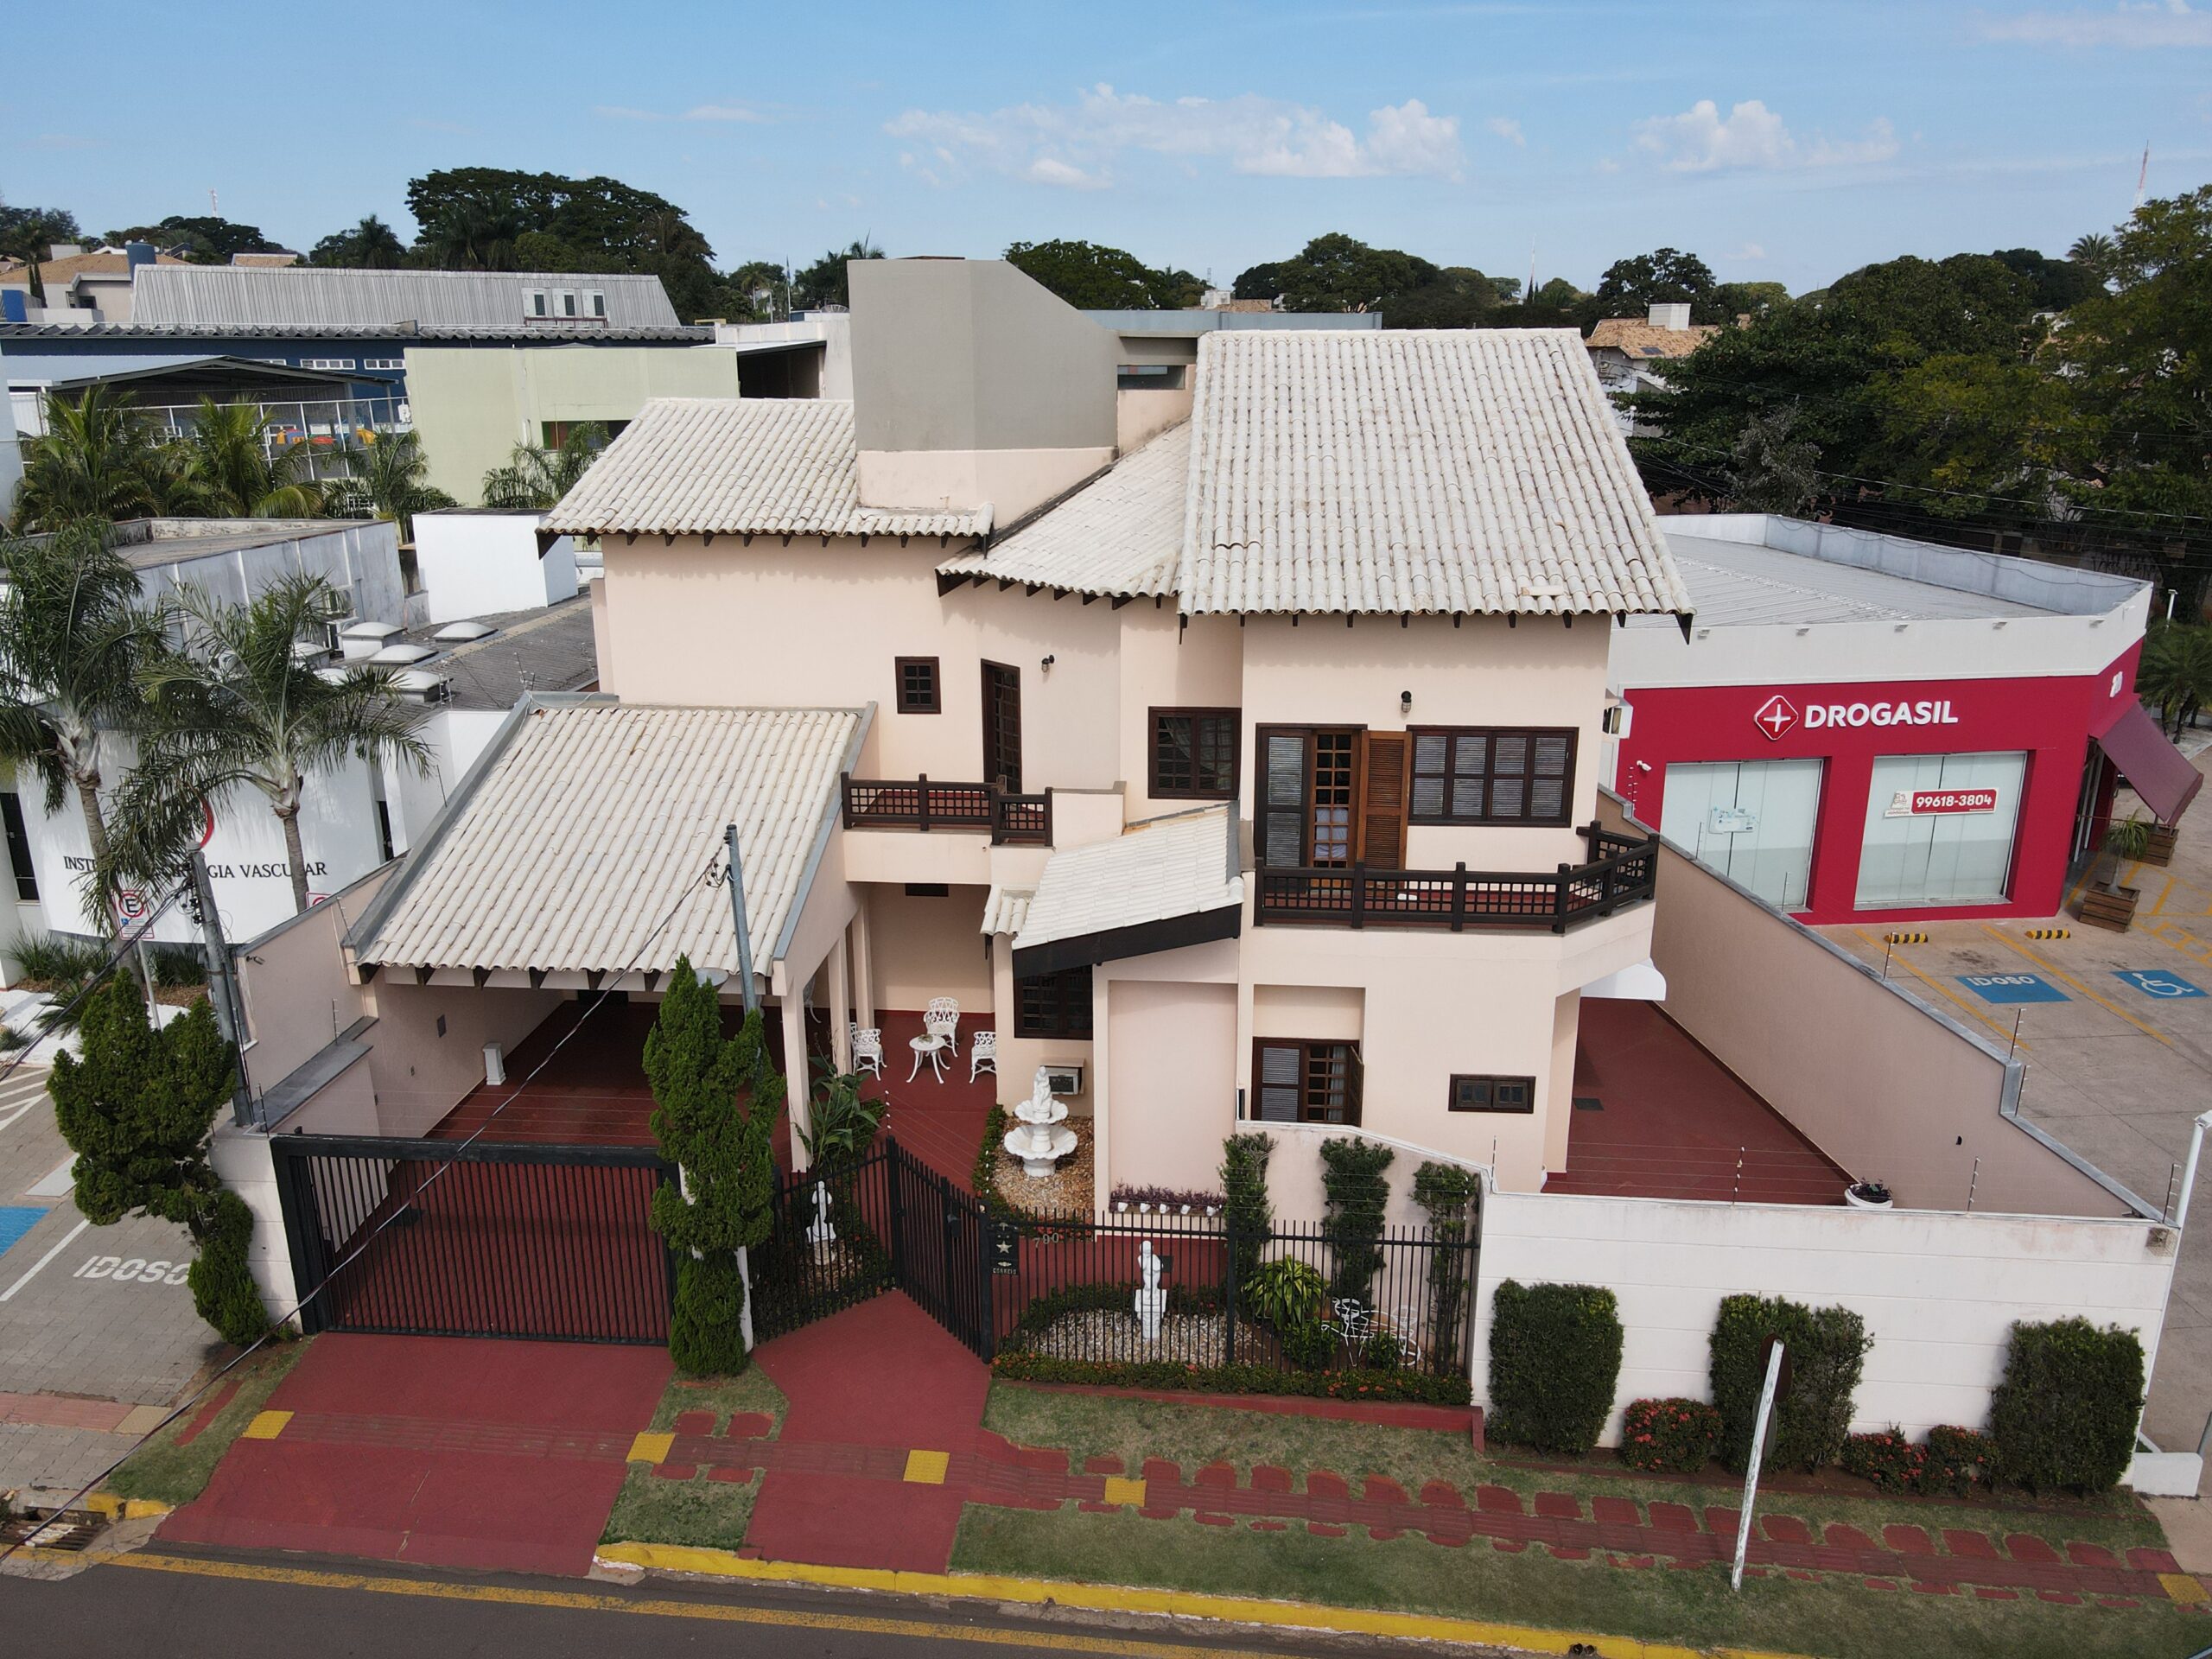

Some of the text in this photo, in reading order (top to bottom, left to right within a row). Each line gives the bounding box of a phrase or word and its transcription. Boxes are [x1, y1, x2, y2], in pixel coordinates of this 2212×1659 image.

[1804, 701, 1959, 728] DROGASIL
[1916, 794, 1993, 808] 99618-3804
[239, 862, 328, 878] VASCUAR
[124, 898, 138, 913] E
[1967, 976, 2036, 986] IDOSO
[1033, 1232, 1060, 1249] 790
